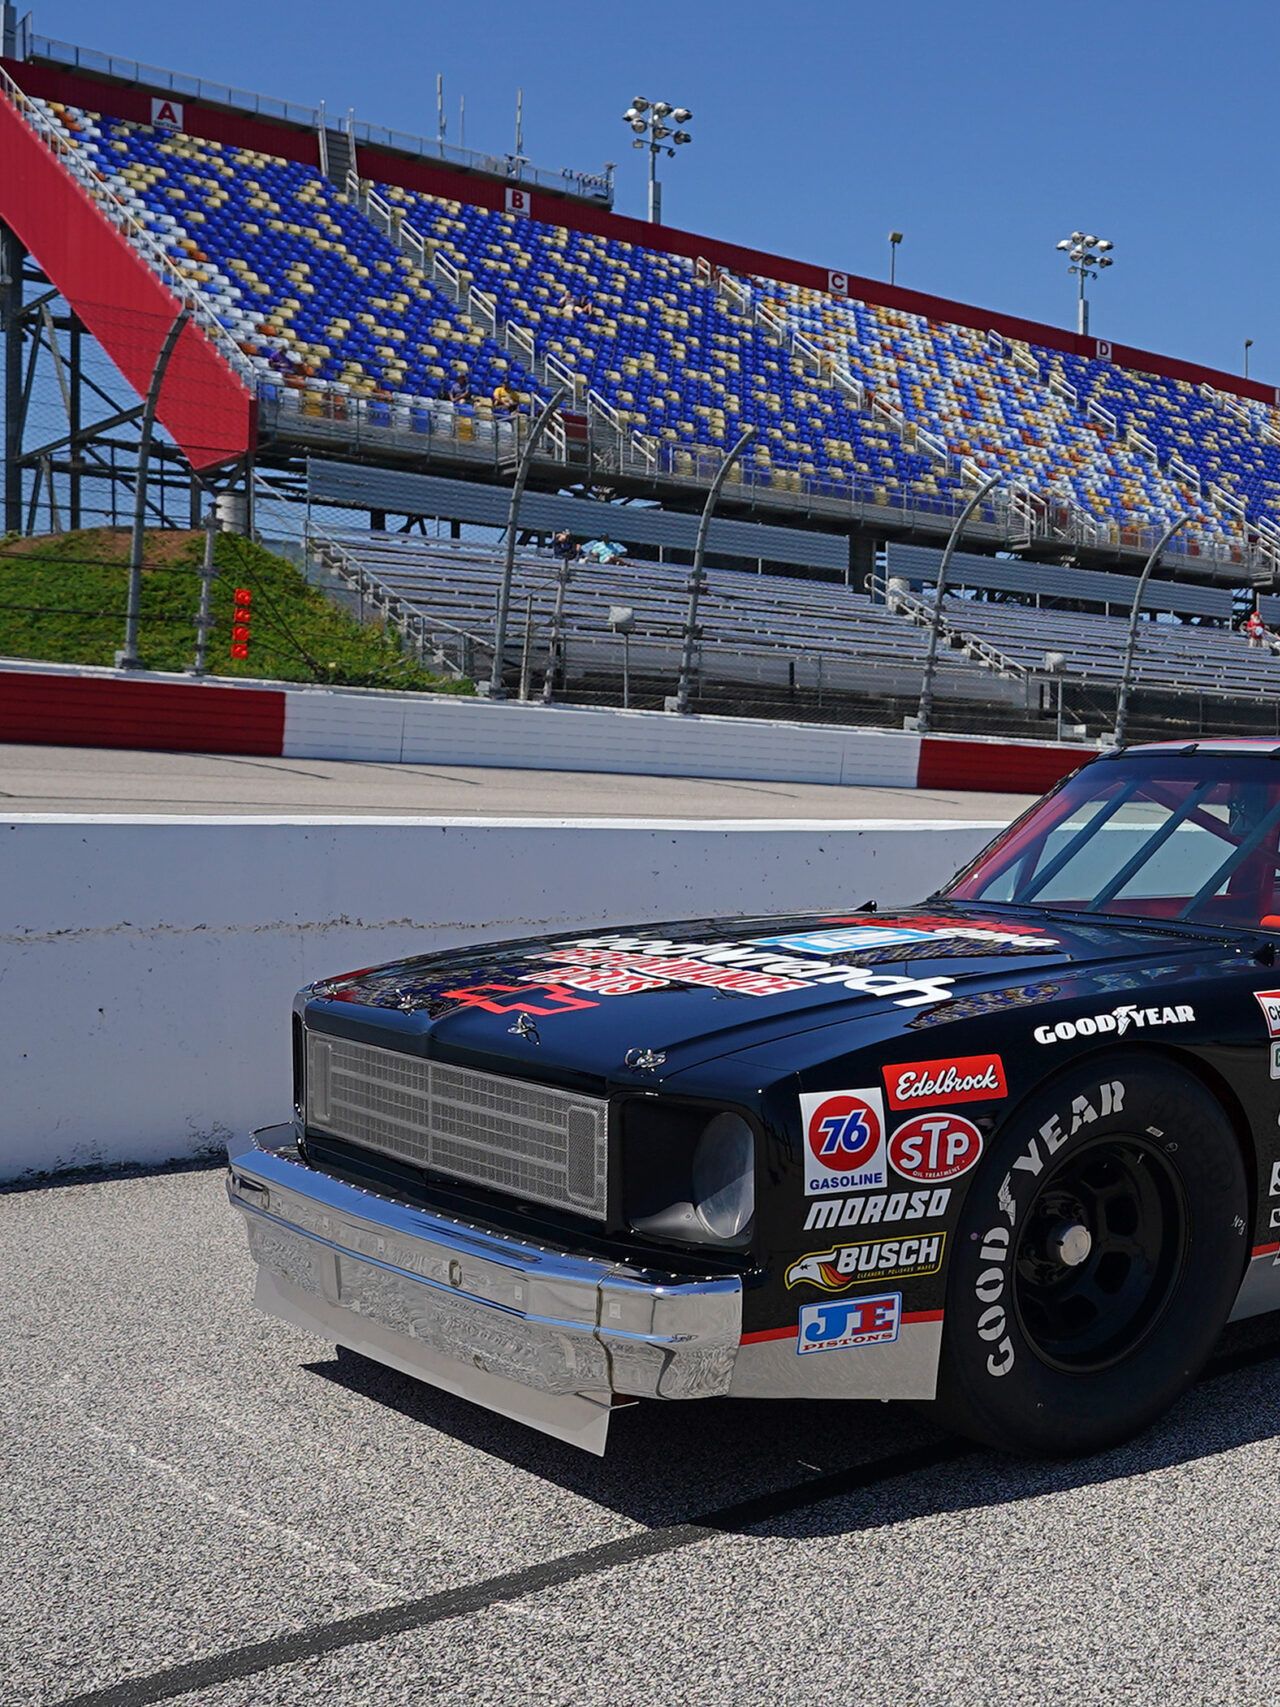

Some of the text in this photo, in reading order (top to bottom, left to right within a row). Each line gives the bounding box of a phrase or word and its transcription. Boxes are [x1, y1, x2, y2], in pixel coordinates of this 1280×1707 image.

[157, 102, 177, 124] A
[512, 190, 524, 209] B
[831, 273, 845, 289] C
[1100, 341, 1109, 355] D
[518, 966, 671, 995] PARTS
[895, 1064, 999, 1101] Edelbrock
[818, 1109, 870, 1155] 76
[900, 1120, 970, 1169] STP
[809, 1172, 883, 1190] GASOLINE
[912, 1165, 961, 1178] OIL TREATMENT
[803, 1188, 951, 1231] MOROSO
[836, 1237, 940, 1274] BUSCH
[805, 1300, 896, 1342] JE
[802, 1332, 893, 1351] PISTONS
